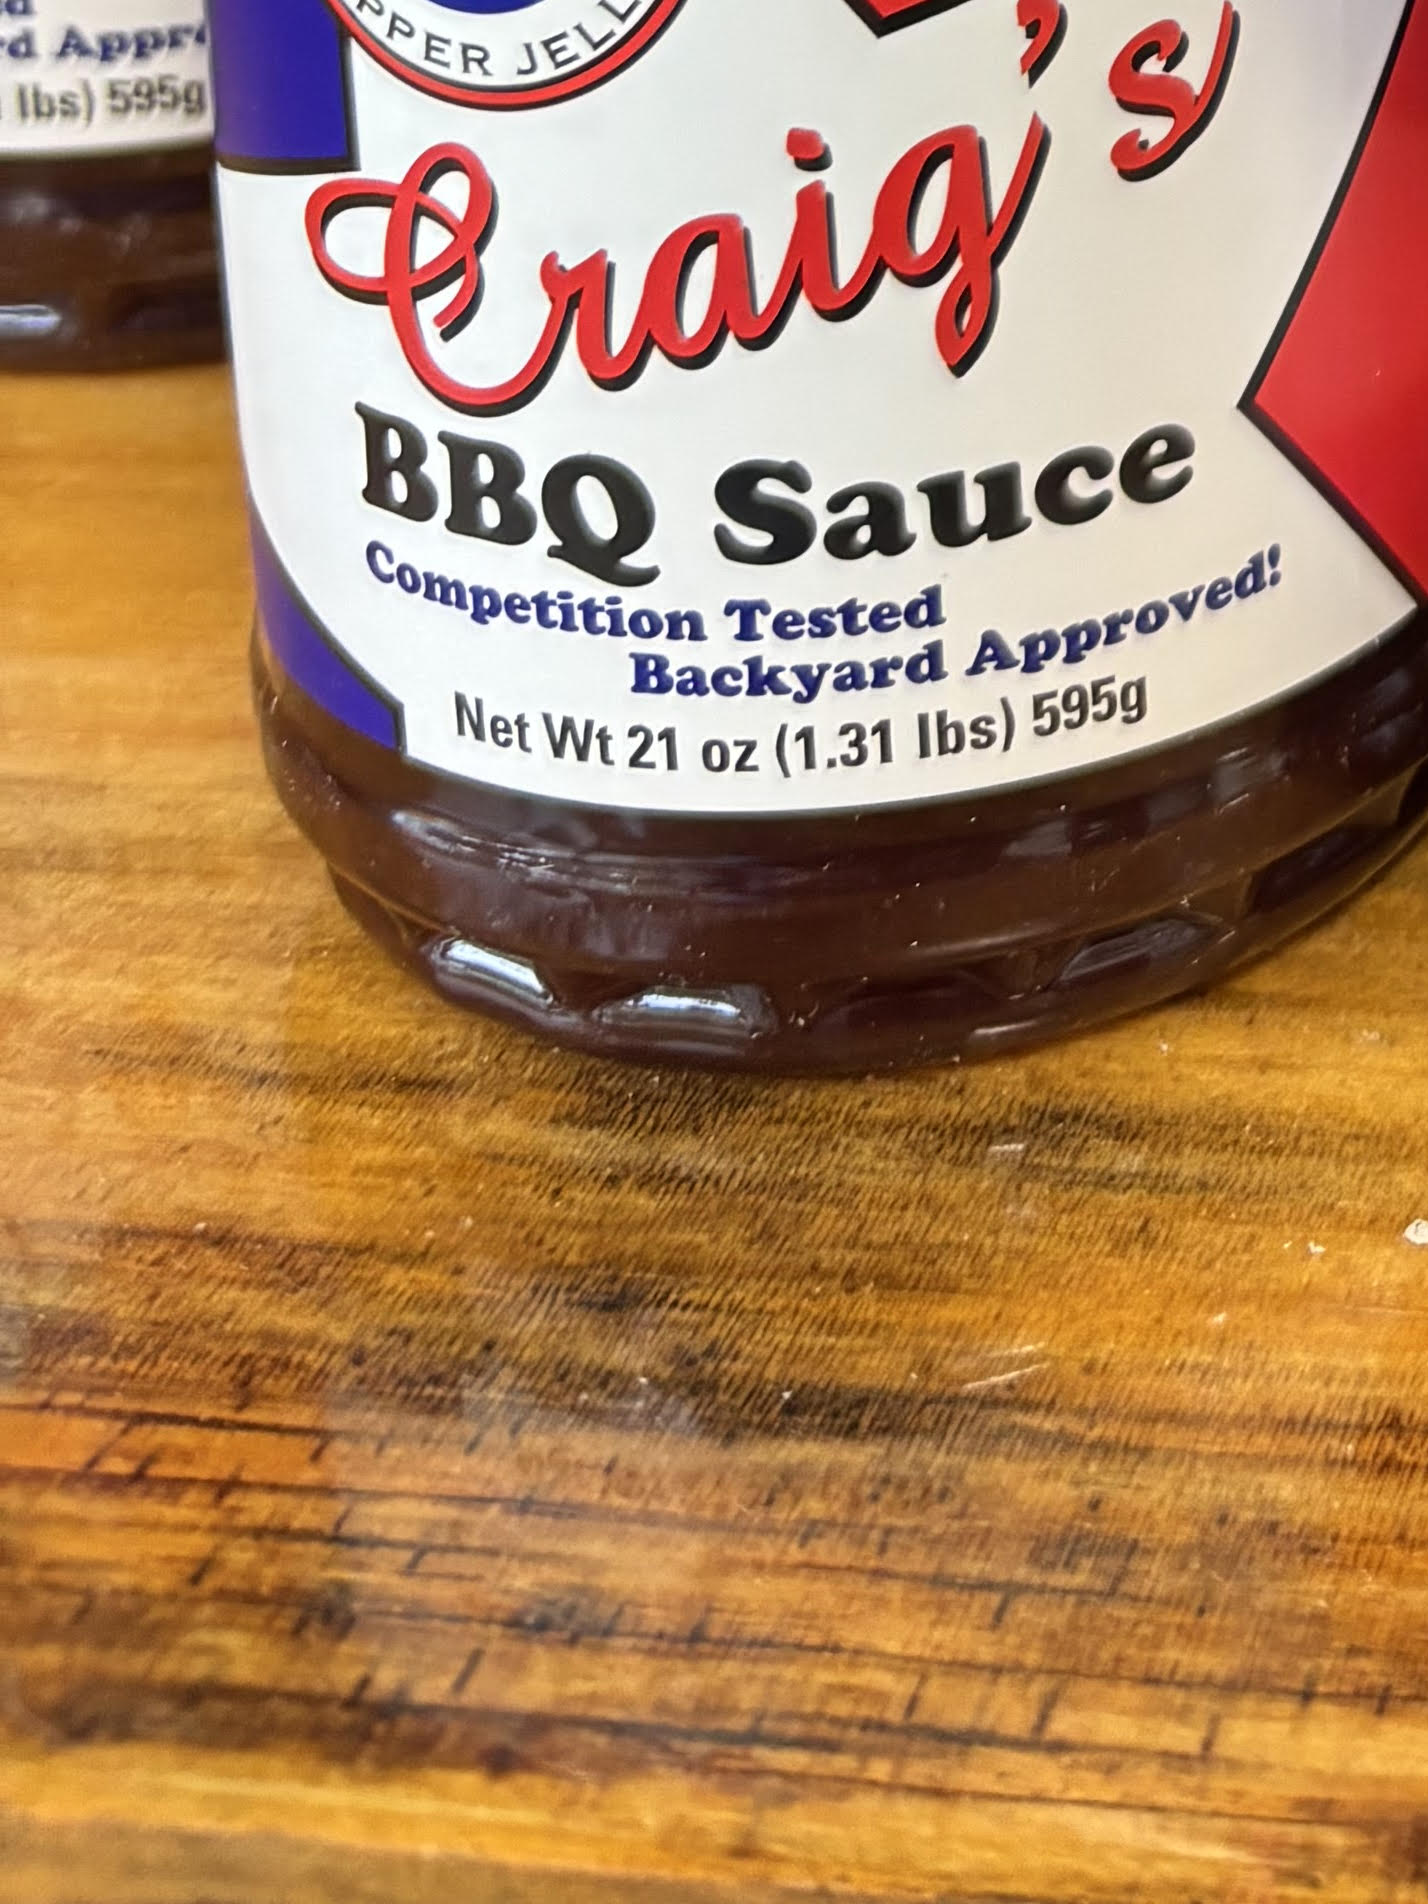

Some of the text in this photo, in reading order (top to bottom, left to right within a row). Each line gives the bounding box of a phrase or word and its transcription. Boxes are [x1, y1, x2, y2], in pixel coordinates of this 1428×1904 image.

[15, 78, 96, 128] lbs)
[354, 400, 1197, 586] BBQ Sauce
[365, 539, 947, 644] Competition Tested
[629, 544, 1284, 703] Backyard Approved!
[454, 674, 1148, 778] Net Wt 21 oz (1.31 lbs) 595g
